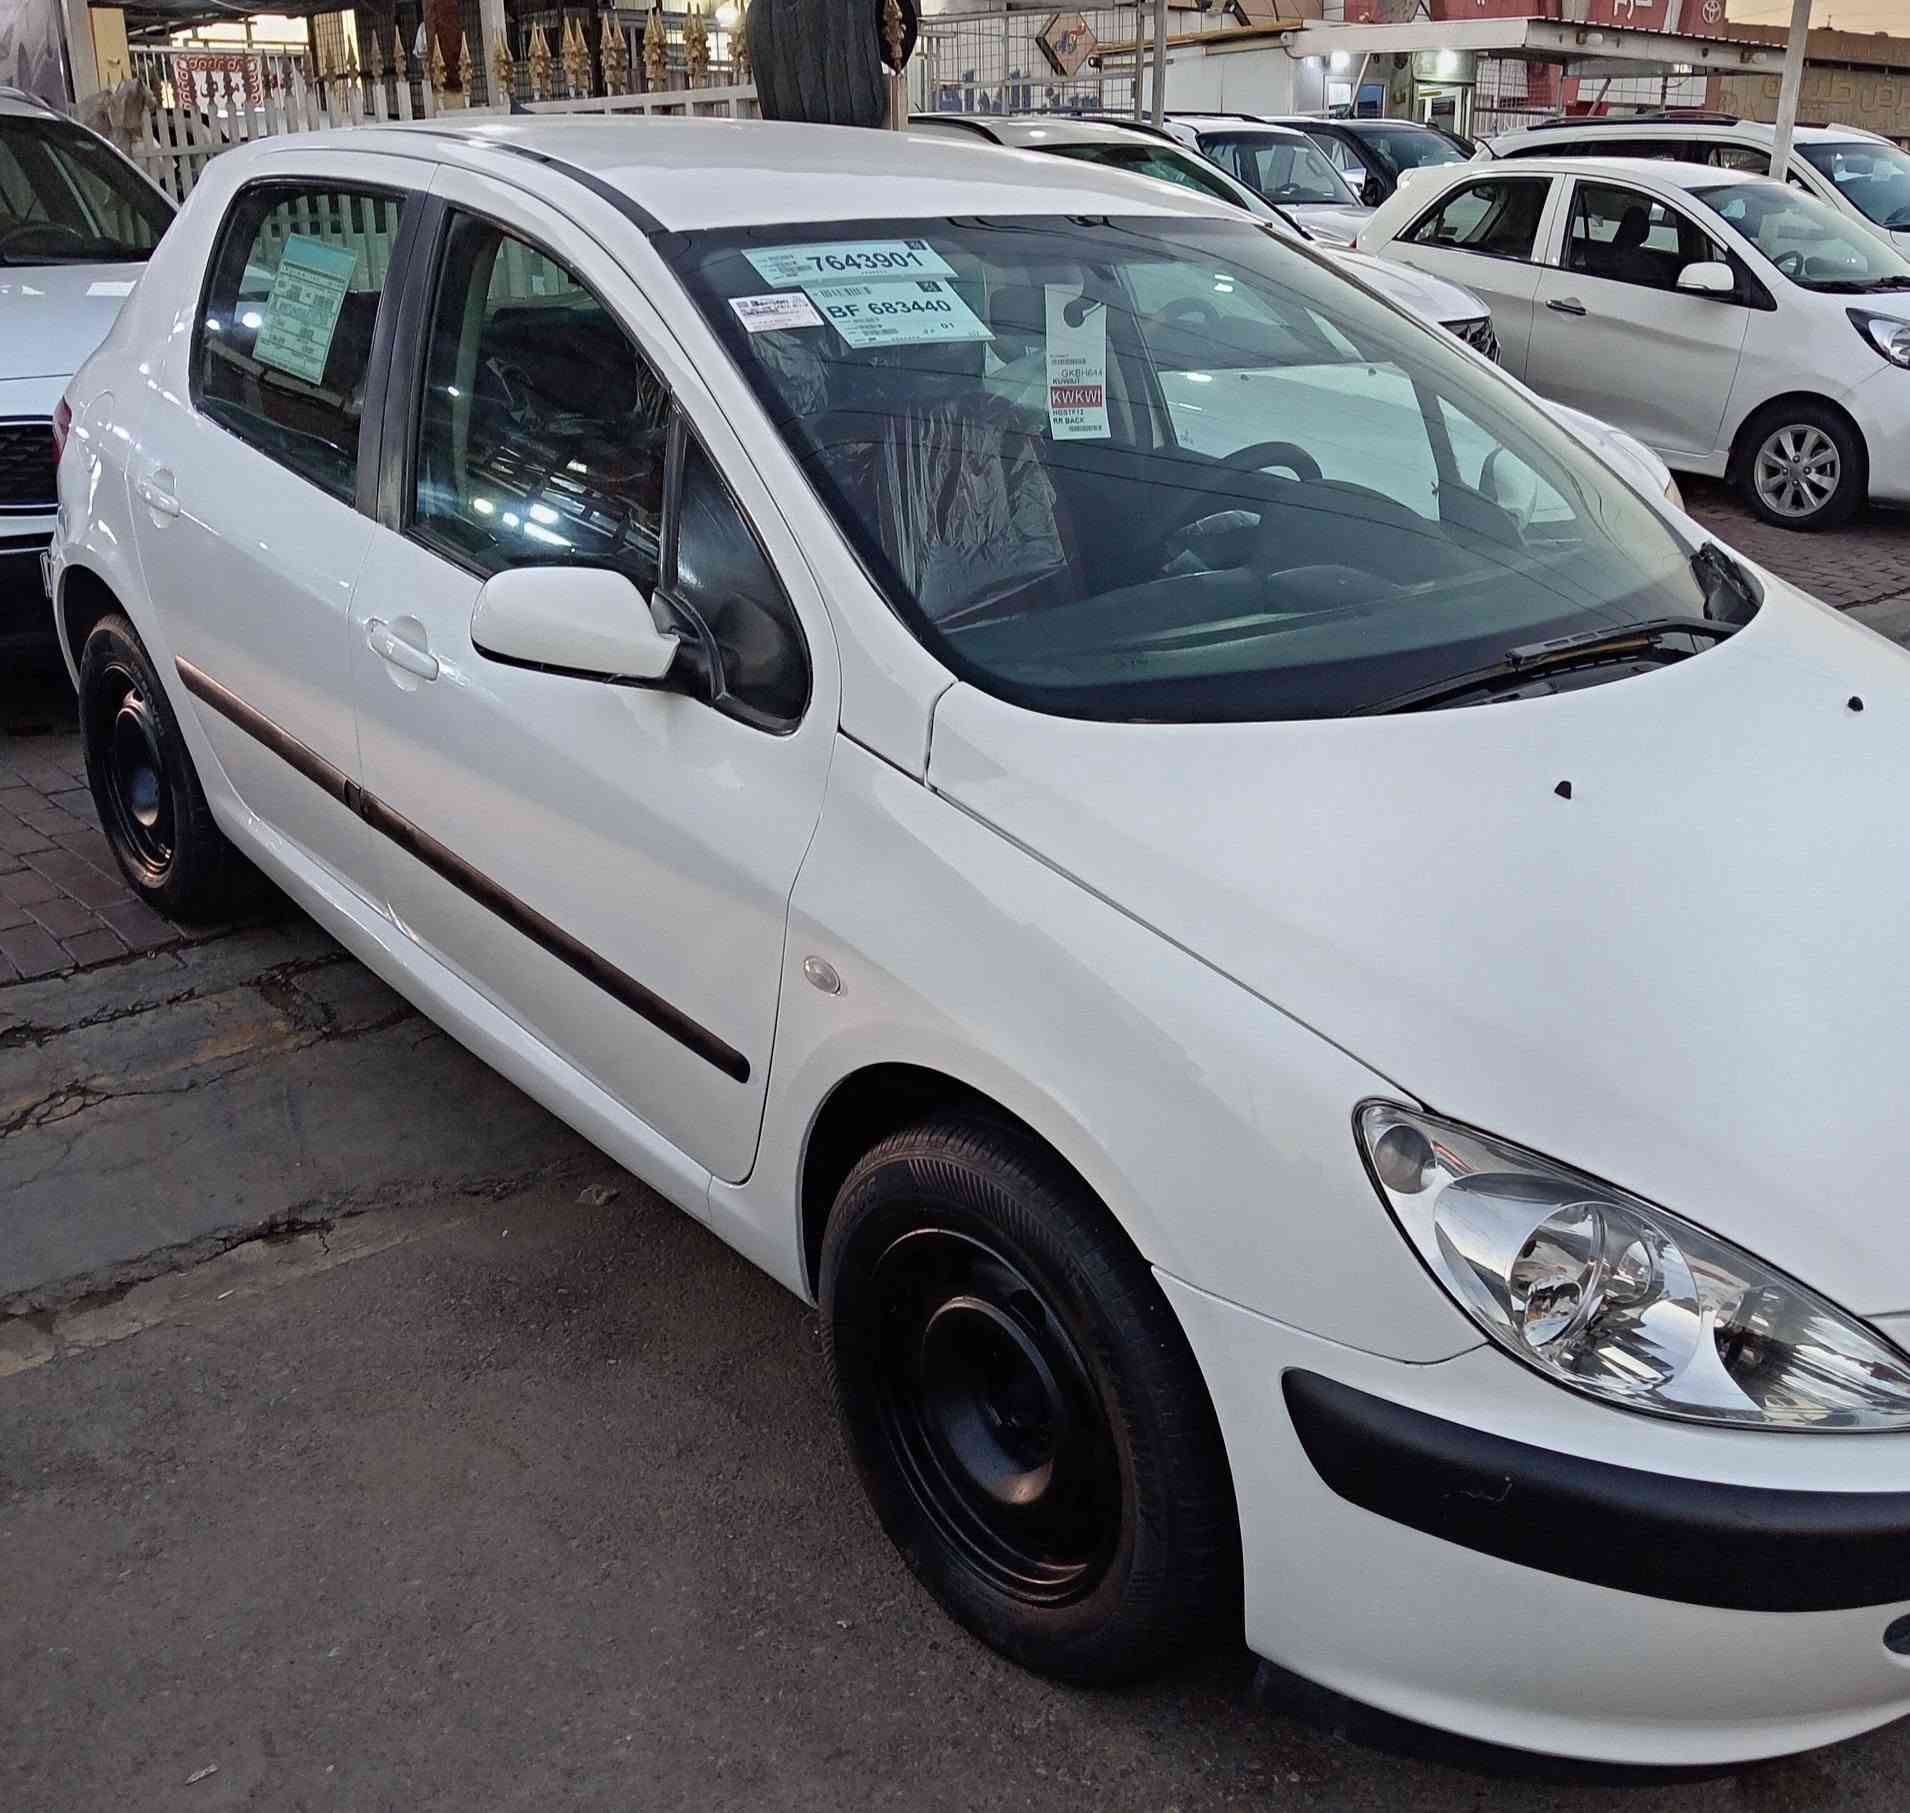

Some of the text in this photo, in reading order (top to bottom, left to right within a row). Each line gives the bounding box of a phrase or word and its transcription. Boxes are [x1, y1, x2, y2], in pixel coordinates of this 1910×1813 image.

[805, 251, 923, 273] 7643901
[826, 304, 863, 320] BF
[868, 299, 952, 316] 683440
[1052, 388, 1102, 405] KWKWI
